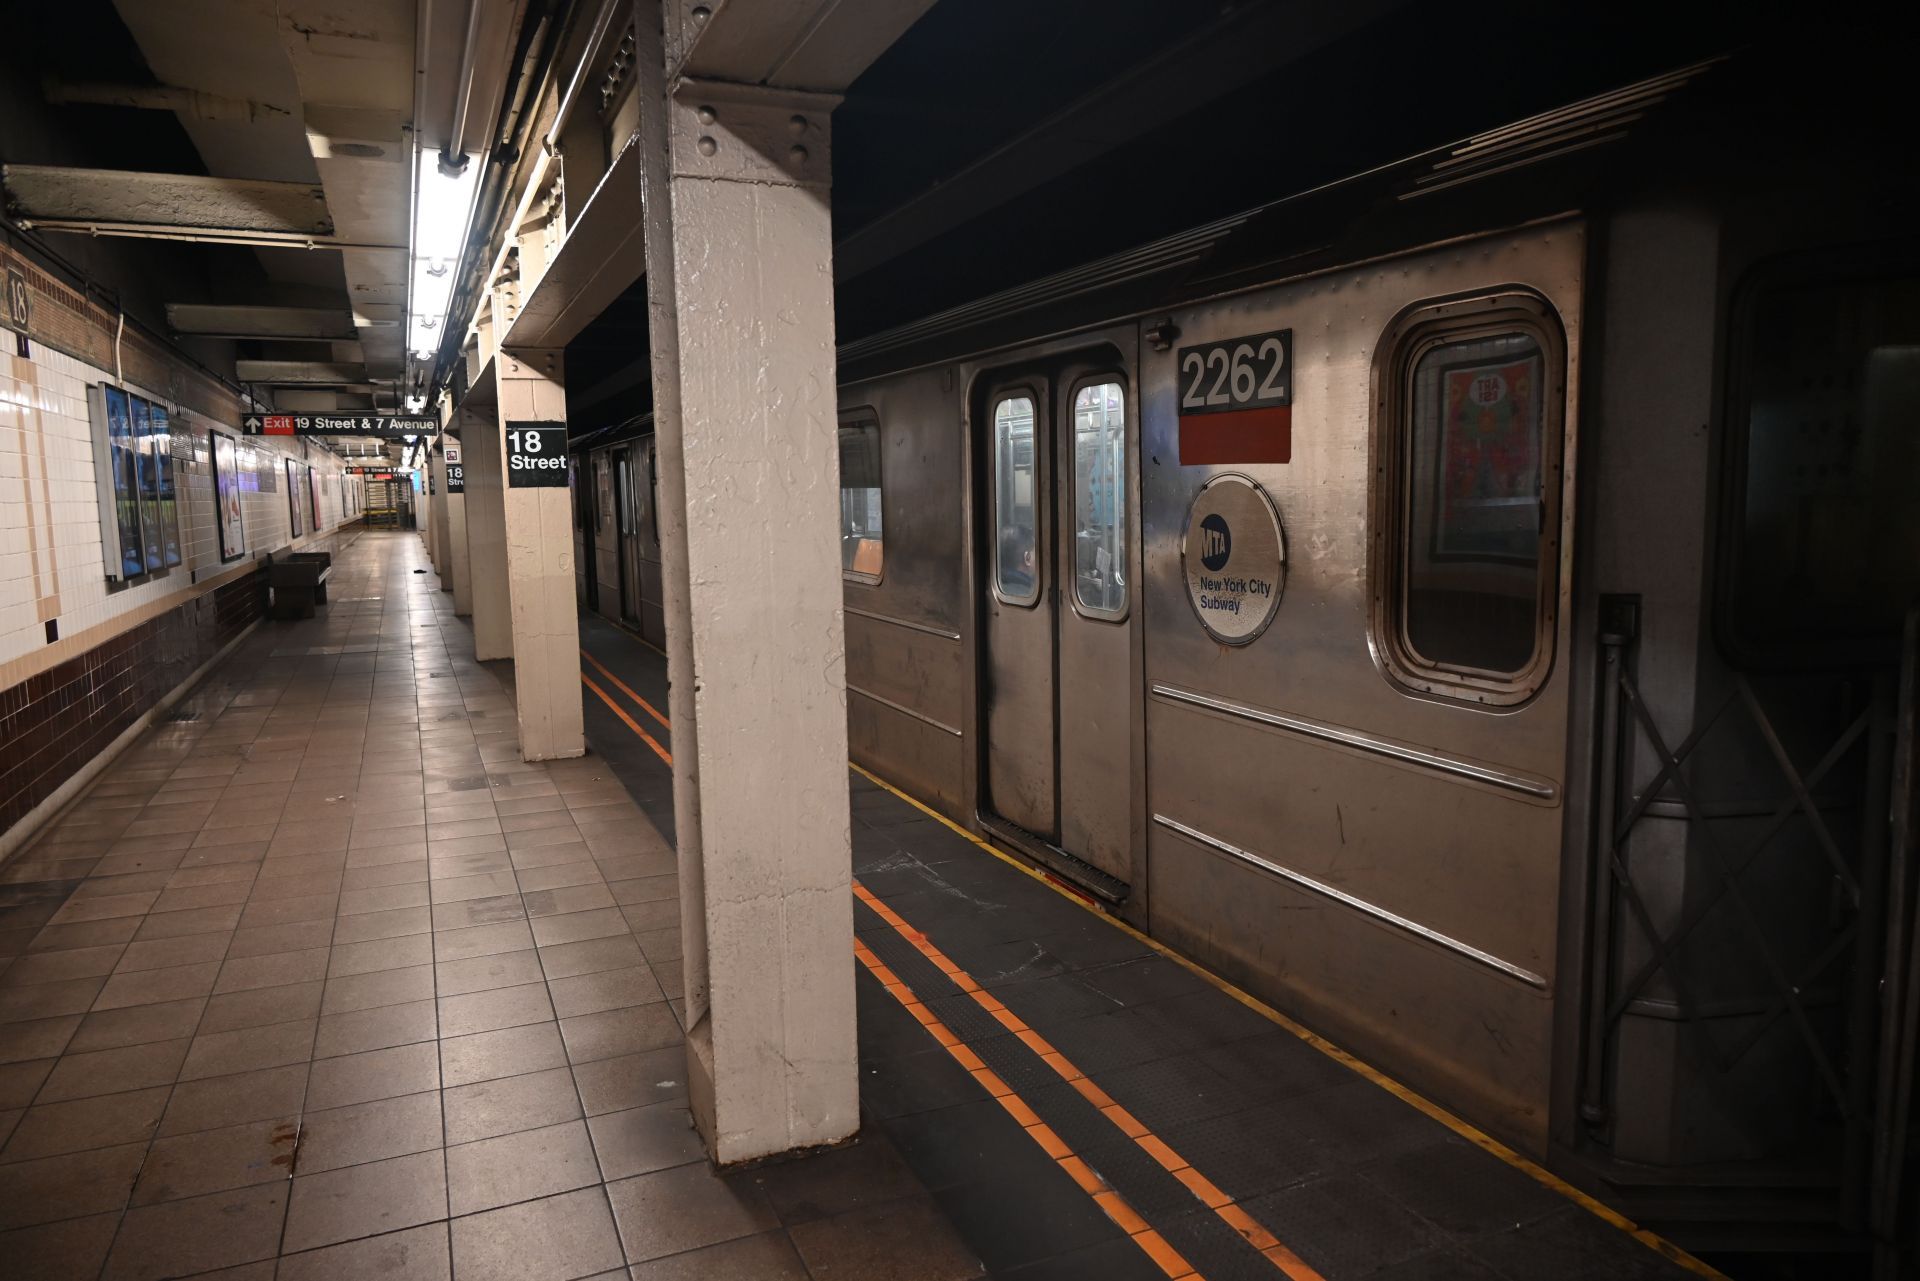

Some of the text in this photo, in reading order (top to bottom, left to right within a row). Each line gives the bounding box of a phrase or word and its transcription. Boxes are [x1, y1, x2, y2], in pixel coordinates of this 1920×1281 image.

[11, 279, 26, 324] 18
[1183, 338, 1284, 408] 2262
[263, 417, 434, 429] Exit 19 Street & 7 Avenue
[508, 430, 542, 453] 18
[447, 468, 463, 478] 18
[510, 454, 567, 470] Street
[1201, 528, 1226, 558] MTA
[1200, 576, 1271, 598] New York City
[1200, 595, 1240, 615] Subway
